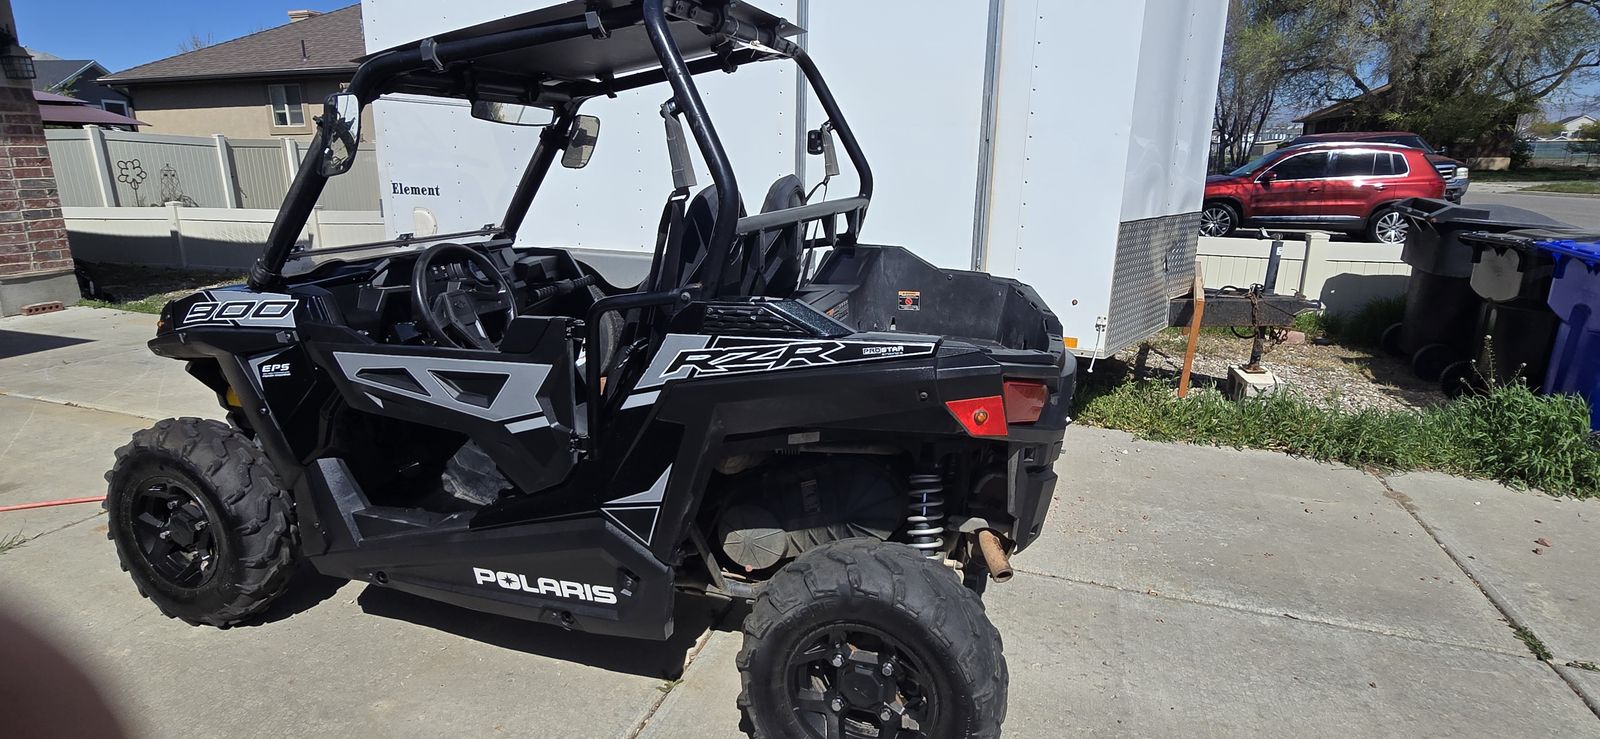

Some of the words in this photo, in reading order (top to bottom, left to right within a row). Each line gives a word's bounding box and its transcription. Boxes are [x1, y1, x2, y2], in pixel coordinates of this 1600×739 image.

[391, 182, 440, 196] Element
[183, 299, 299, 323] 900
[659, 340, 846, 378] RZR
[863, 346, 904, 355] PROSTAR
[262, 363, 290, 372] EPS
[473, 567, 618, 605] POLARIS
